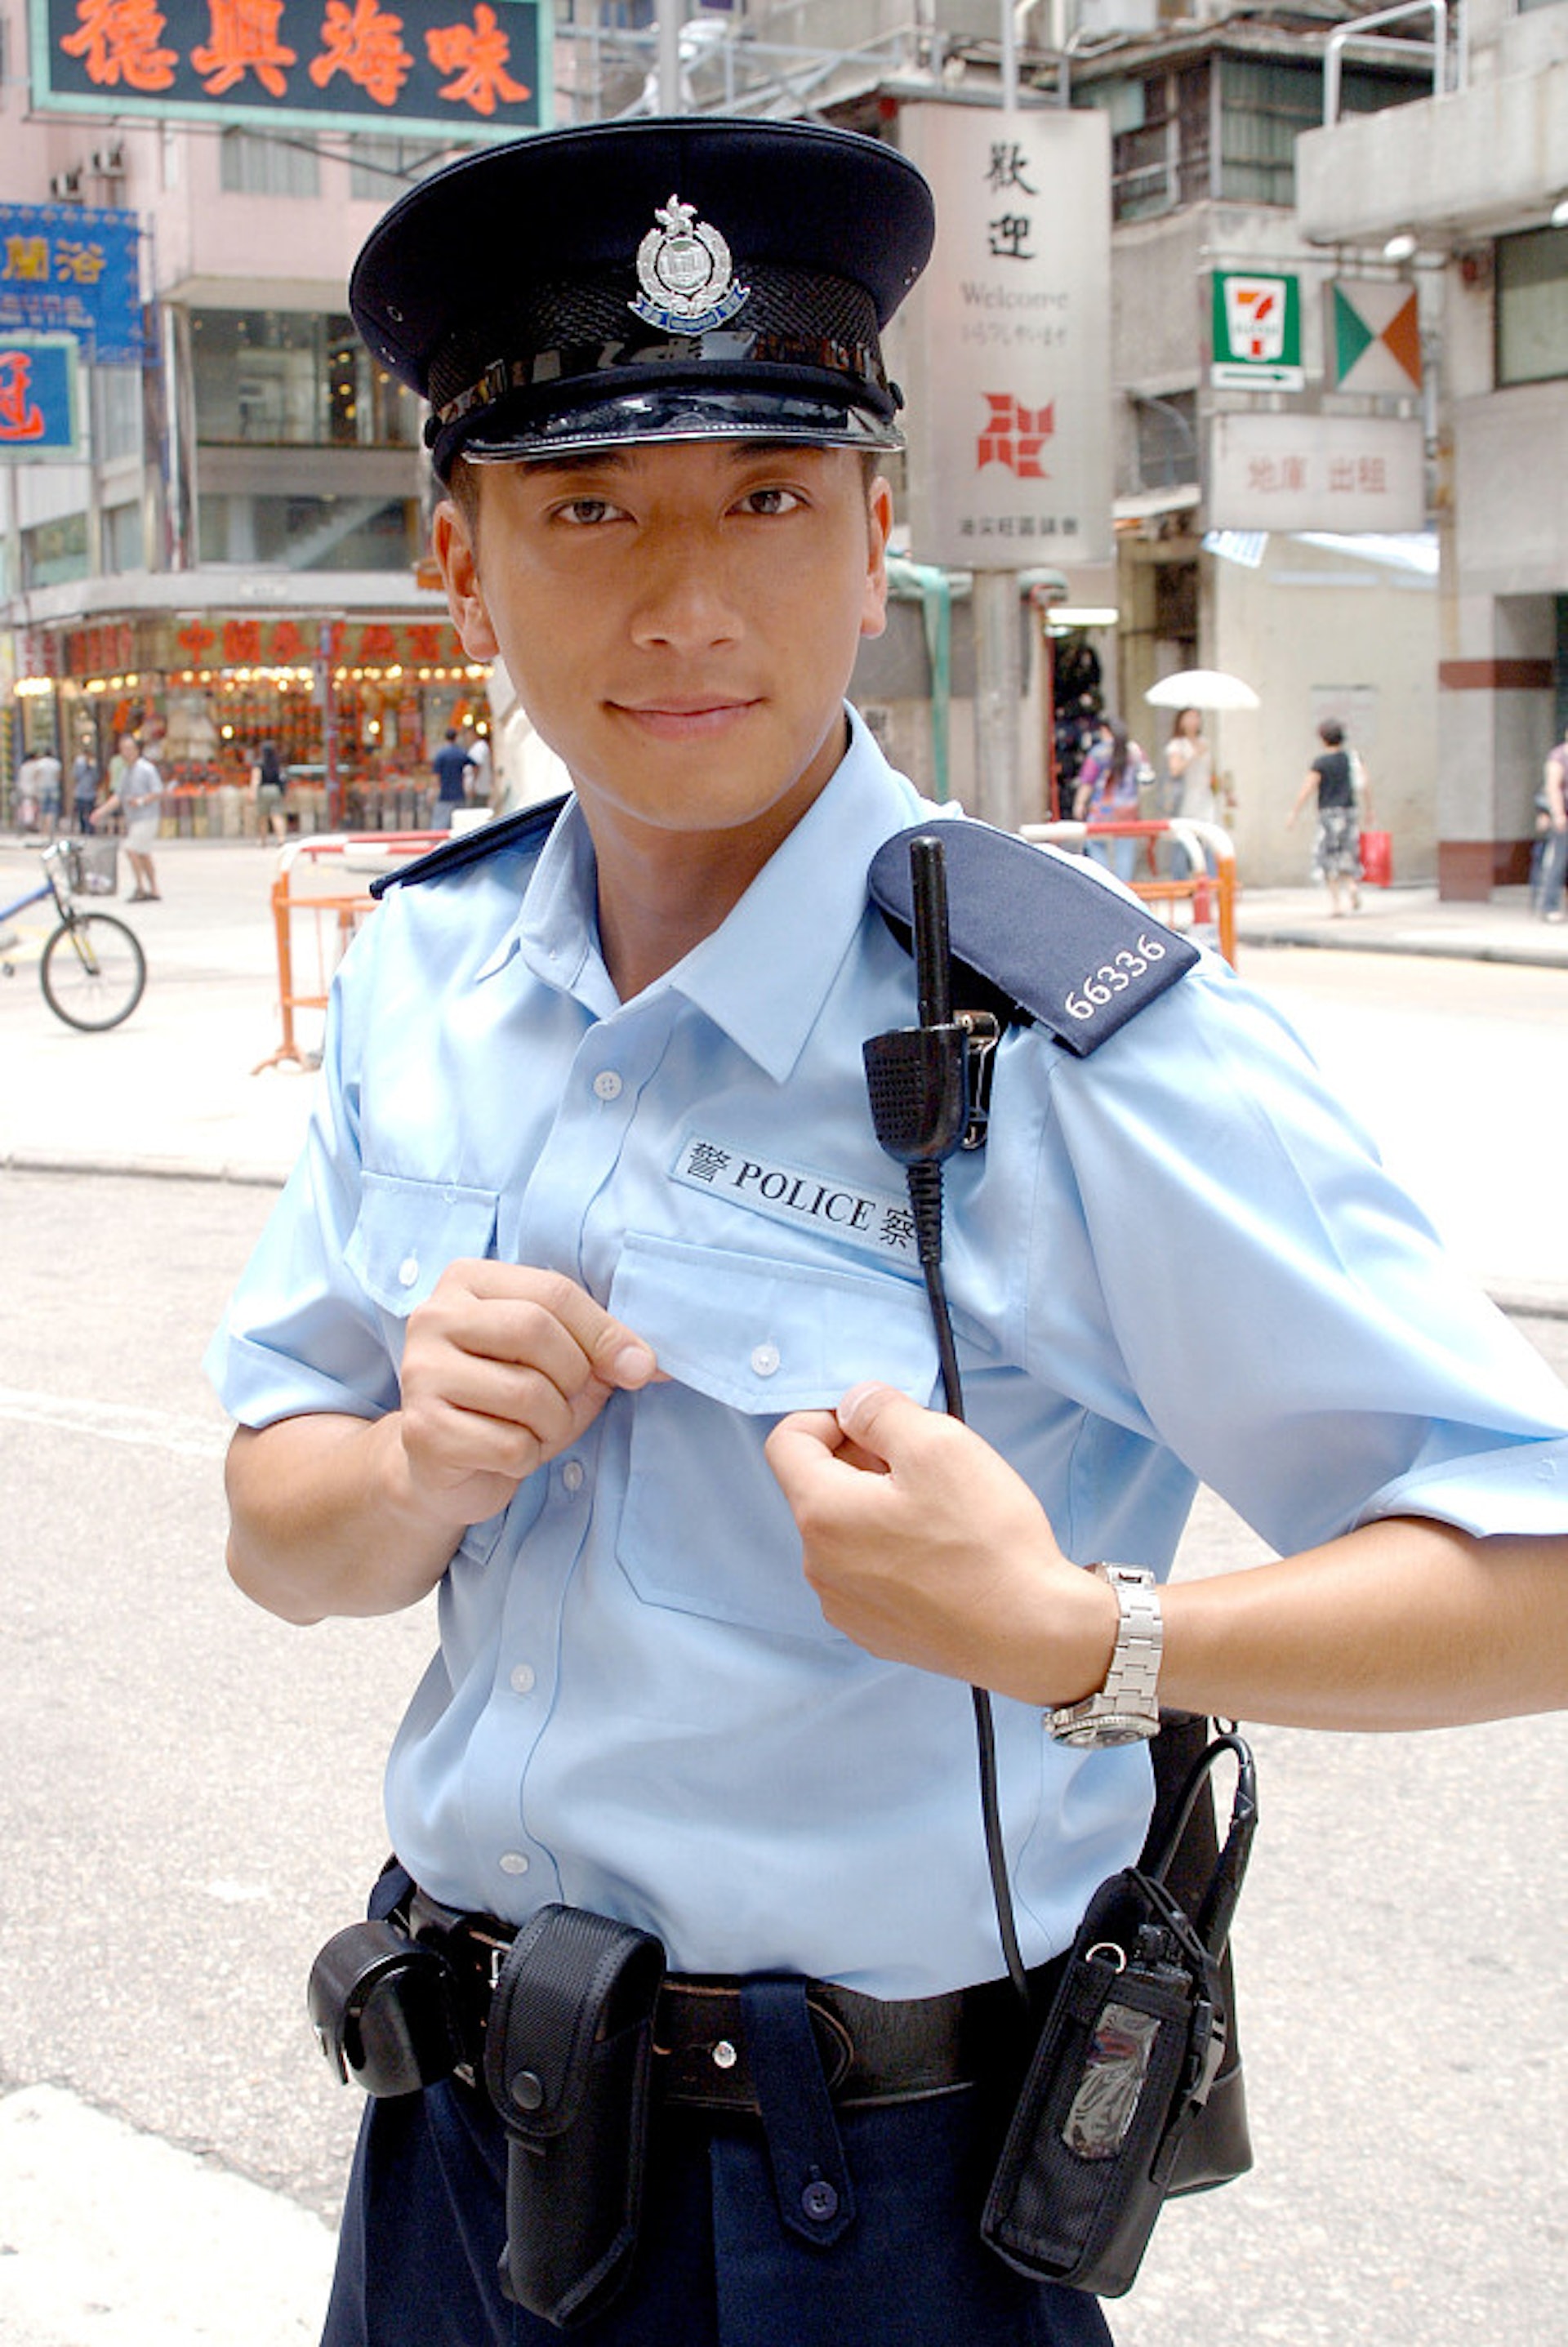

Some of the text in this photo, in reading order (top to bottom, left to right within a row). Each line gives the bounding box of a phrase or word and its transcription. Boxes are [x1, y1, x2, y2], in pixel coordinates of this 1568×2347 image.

[60, 0, 532, 115] 德興海味
[982, 141, 1039, 261] 歡迎
[960, 279, 1069, 310] Welcome
[1064, 933, 1166, 1020] 66336
[687, 1142, 915, 1249] 警 POLICE 察
